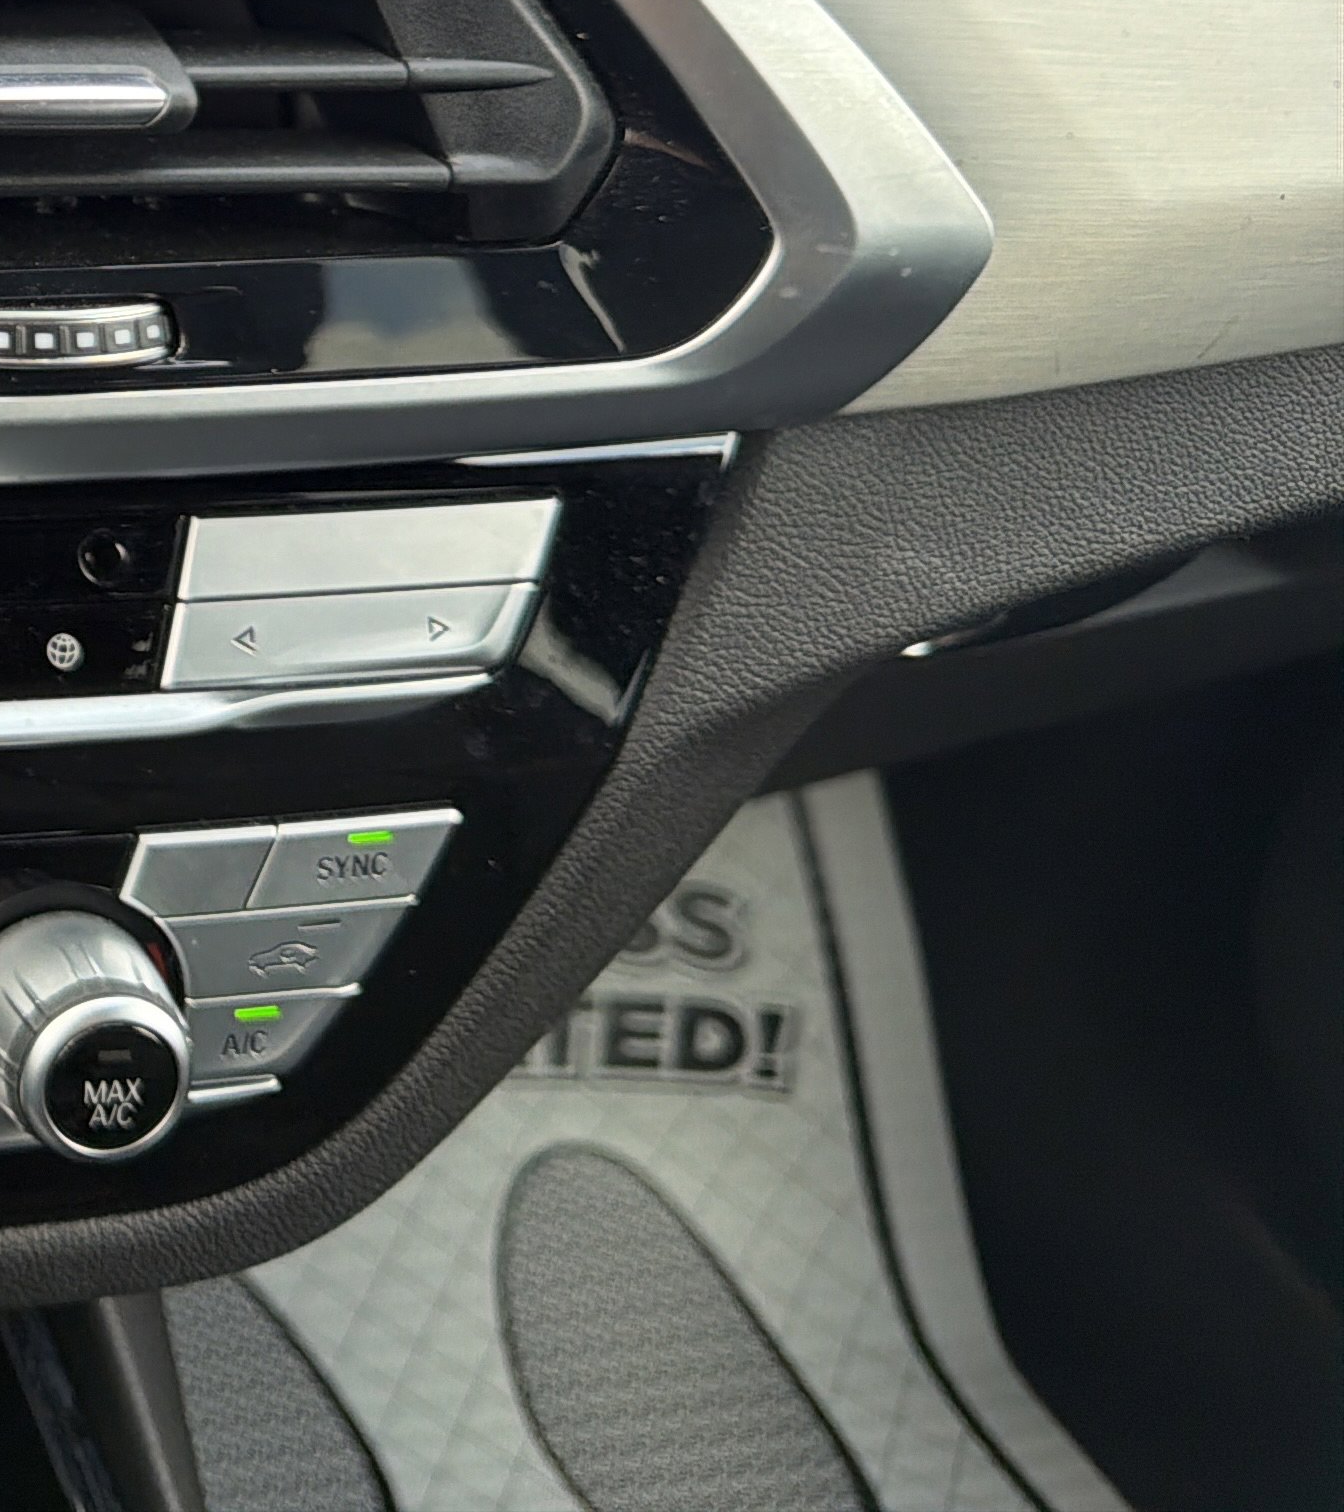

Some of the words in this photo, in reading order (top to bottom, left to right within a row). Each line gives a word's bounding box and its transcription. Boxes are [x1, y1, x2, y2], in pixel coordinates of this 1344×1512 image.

[315, 851, 391, 883] SYNC
[220, 1029, 272, 1059] A/C
[82, 1076, 145, 1107] MAX
[88, 1100, 136, 1129] A/C
